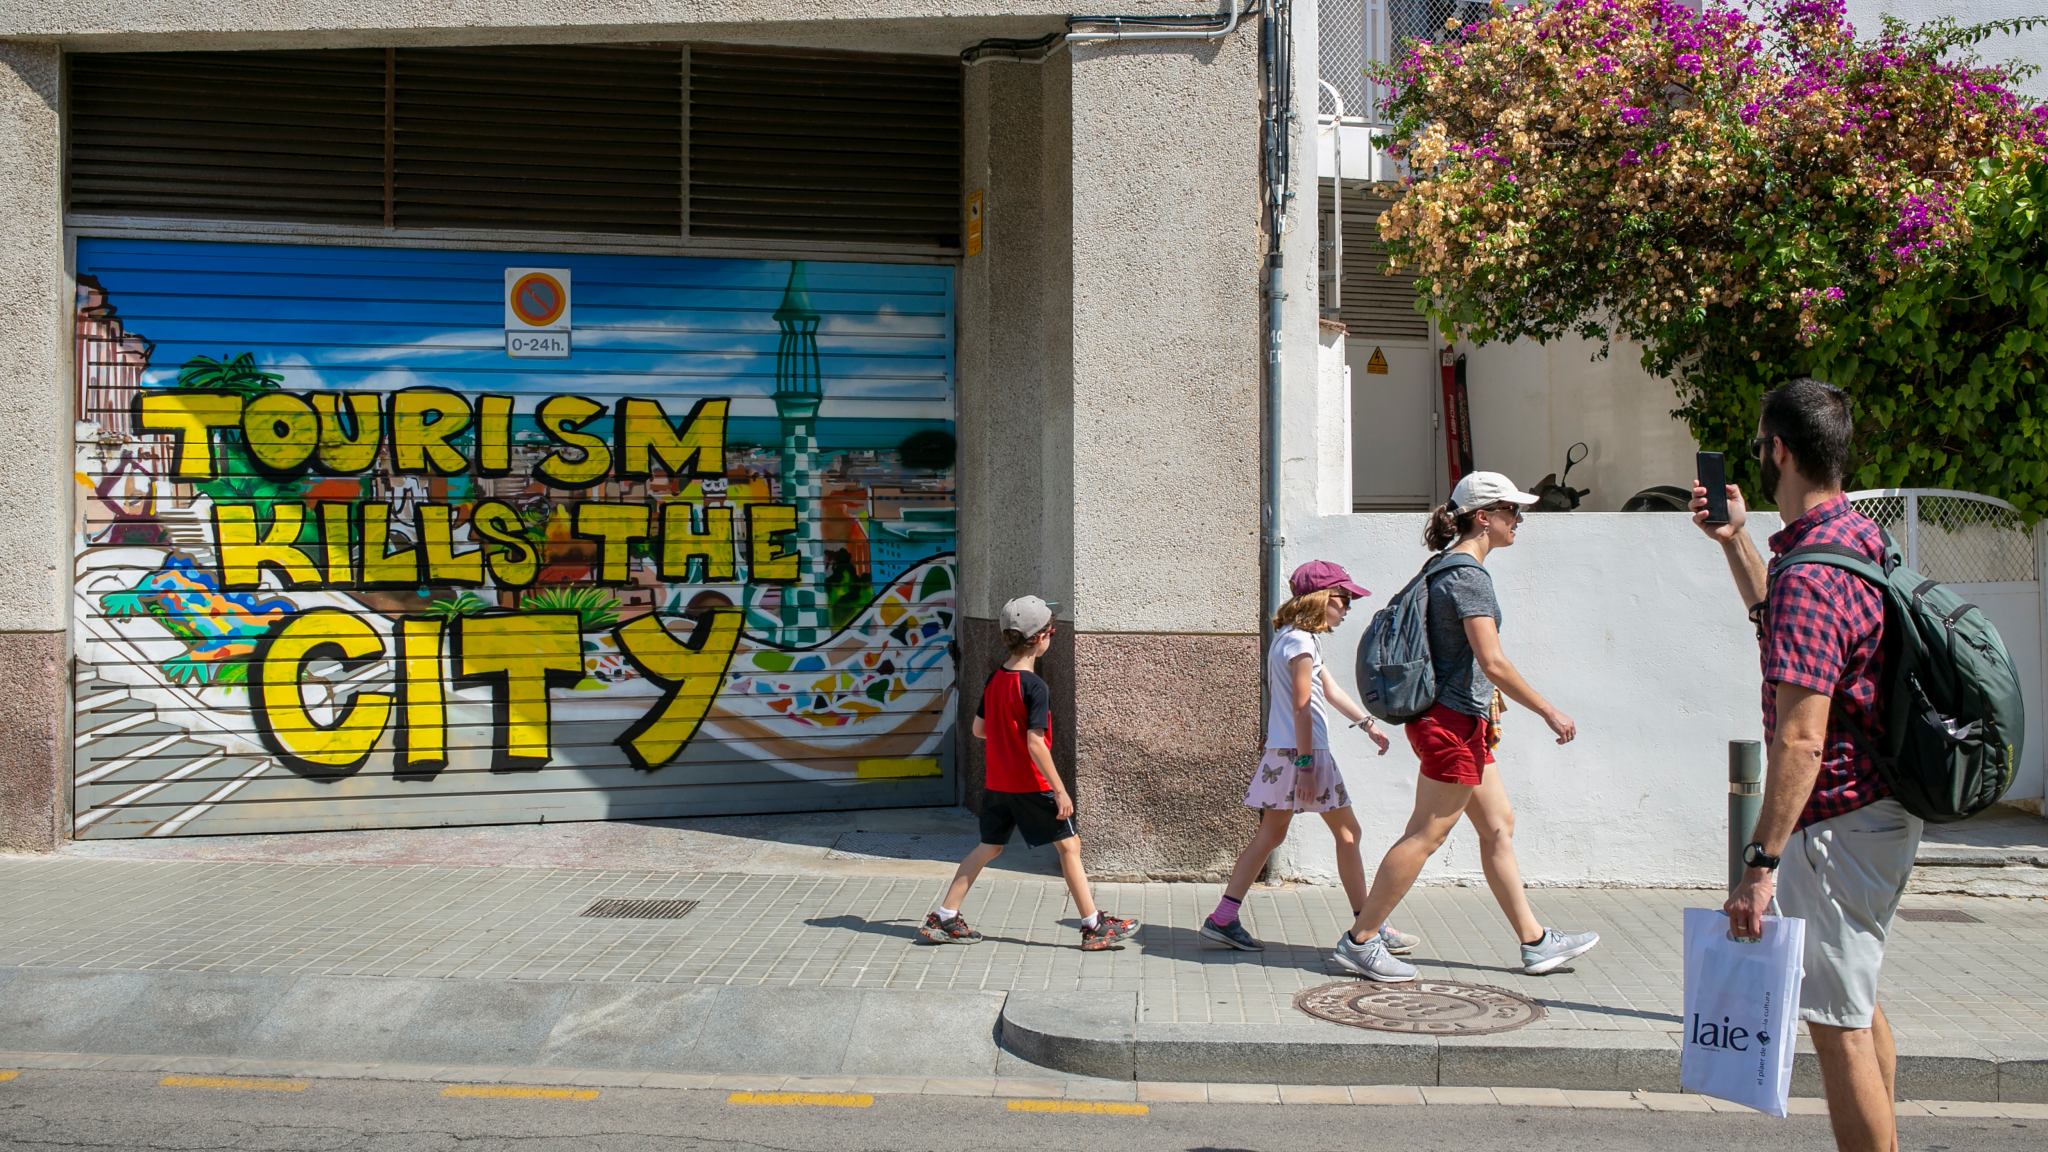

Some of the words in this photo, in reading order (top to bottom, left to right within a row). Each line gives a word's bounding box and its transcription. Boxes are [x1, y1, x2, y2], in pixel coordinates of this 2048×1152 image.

[511, 338, 565, 352] 0-24h.
[1448, 394, 1457, 435] FISCHER
[132, 386, 731, 490] TOURISM
[210, 502, 541, 593] KILLS
[571, 502, 801, 585] THE
[250, 609, 747, 783] CITY
[1763, 991, 1771, 1018] cultura
[1690, 1013, 1749, 1052] laie
[1759, 1047, 1767, 1057] de
[1757, 1058, 1766, 1078] plaer
